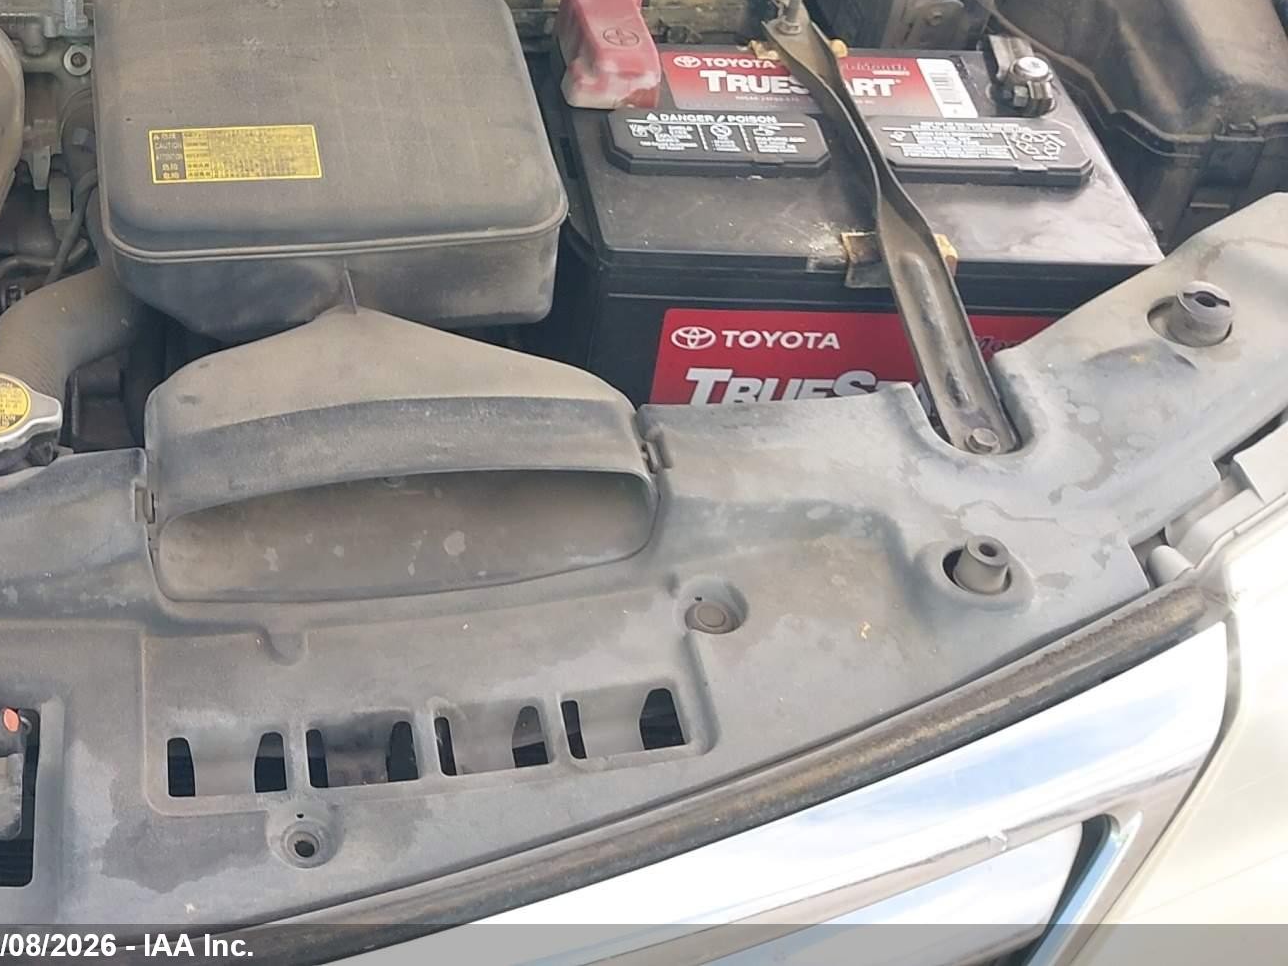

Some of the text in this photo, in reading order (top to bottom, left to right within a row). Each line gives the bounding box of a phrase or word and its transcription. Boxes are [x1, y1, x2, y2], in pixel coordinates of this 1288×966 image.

[702, 57, 777, 70] TOYOTA
[659, 113, 715, 123] DANGER
[727, 114, 778, 124] POISON
[721, 330, 841, 350] TOYOTA
